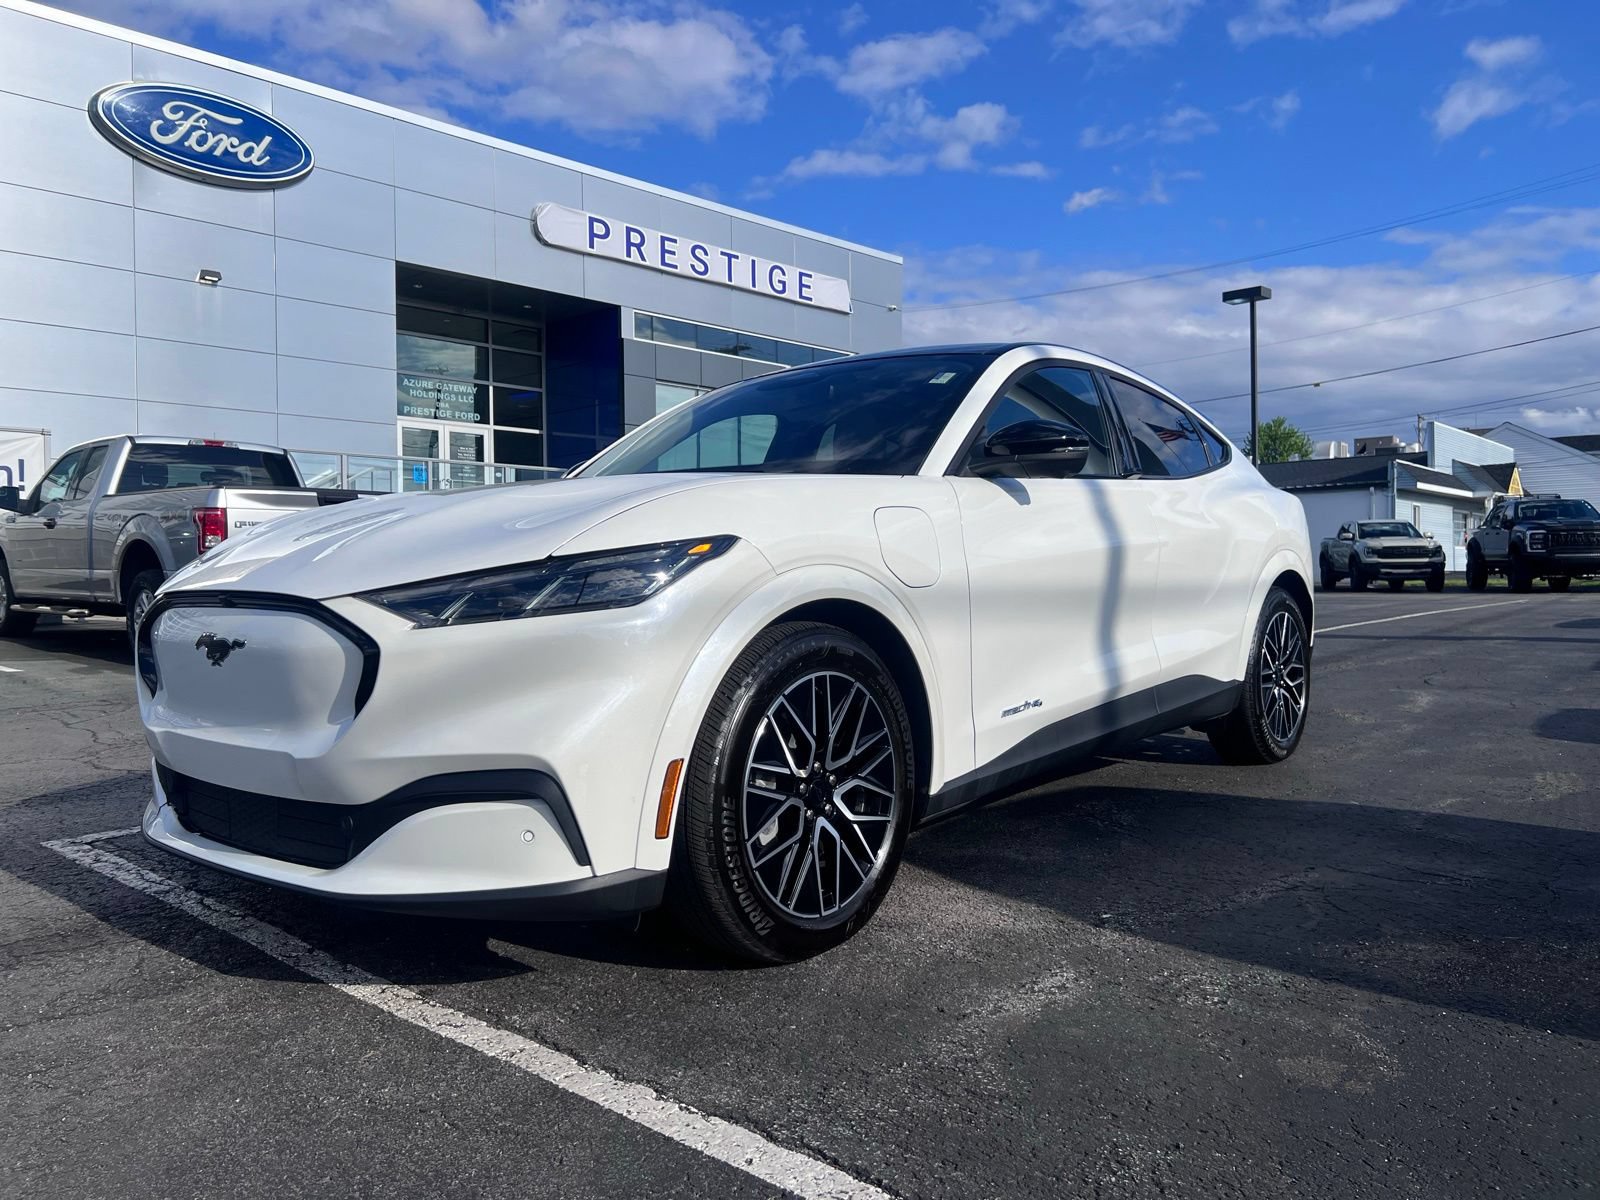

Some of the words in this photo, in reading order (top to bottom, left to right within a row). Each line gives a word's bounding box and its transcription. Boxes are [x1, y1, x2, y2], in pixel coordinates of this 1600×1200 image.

[150, 101, 273, 167] Ford
[587, 215, 814, 302] PRESTIGE
[402, 378, 434, 389] AZURE
[436, 382, 478, 394] GATEWAY
[409, 388, 456, 401] HOLDINGS
[458, 395, 475, 403] LLC
[403, 405, 453, 419] PRESTIGE
[455, 411, 481, 421] FORD
[721, 795, 776, 937] BRIDGESTONE
